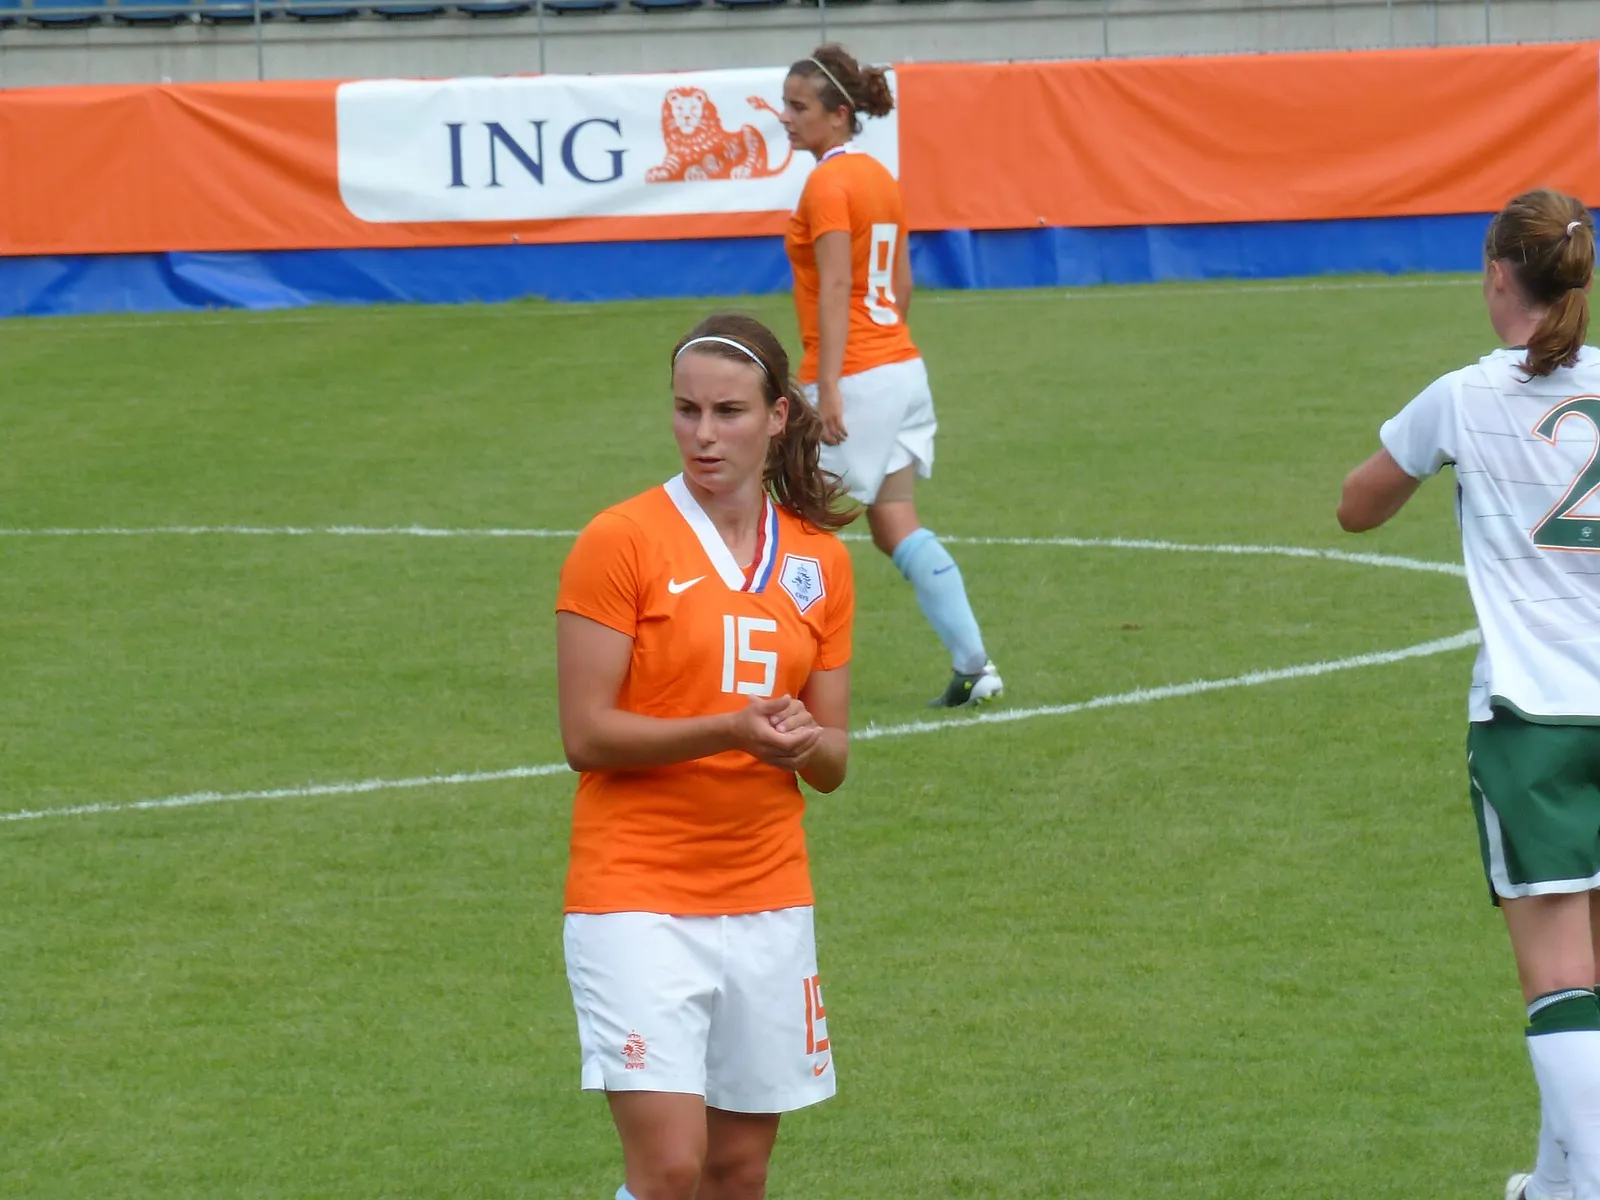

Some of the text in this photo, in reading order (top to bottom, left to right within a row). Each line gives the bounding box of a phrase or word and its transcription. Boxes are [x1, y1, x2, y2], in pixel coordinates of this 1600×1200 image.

[443, 116, 629, 189] ING
[863, 223, 898, 326] 8
[1530, 394, 1600, 553] 2
[721, 614, 778, 698] 15
